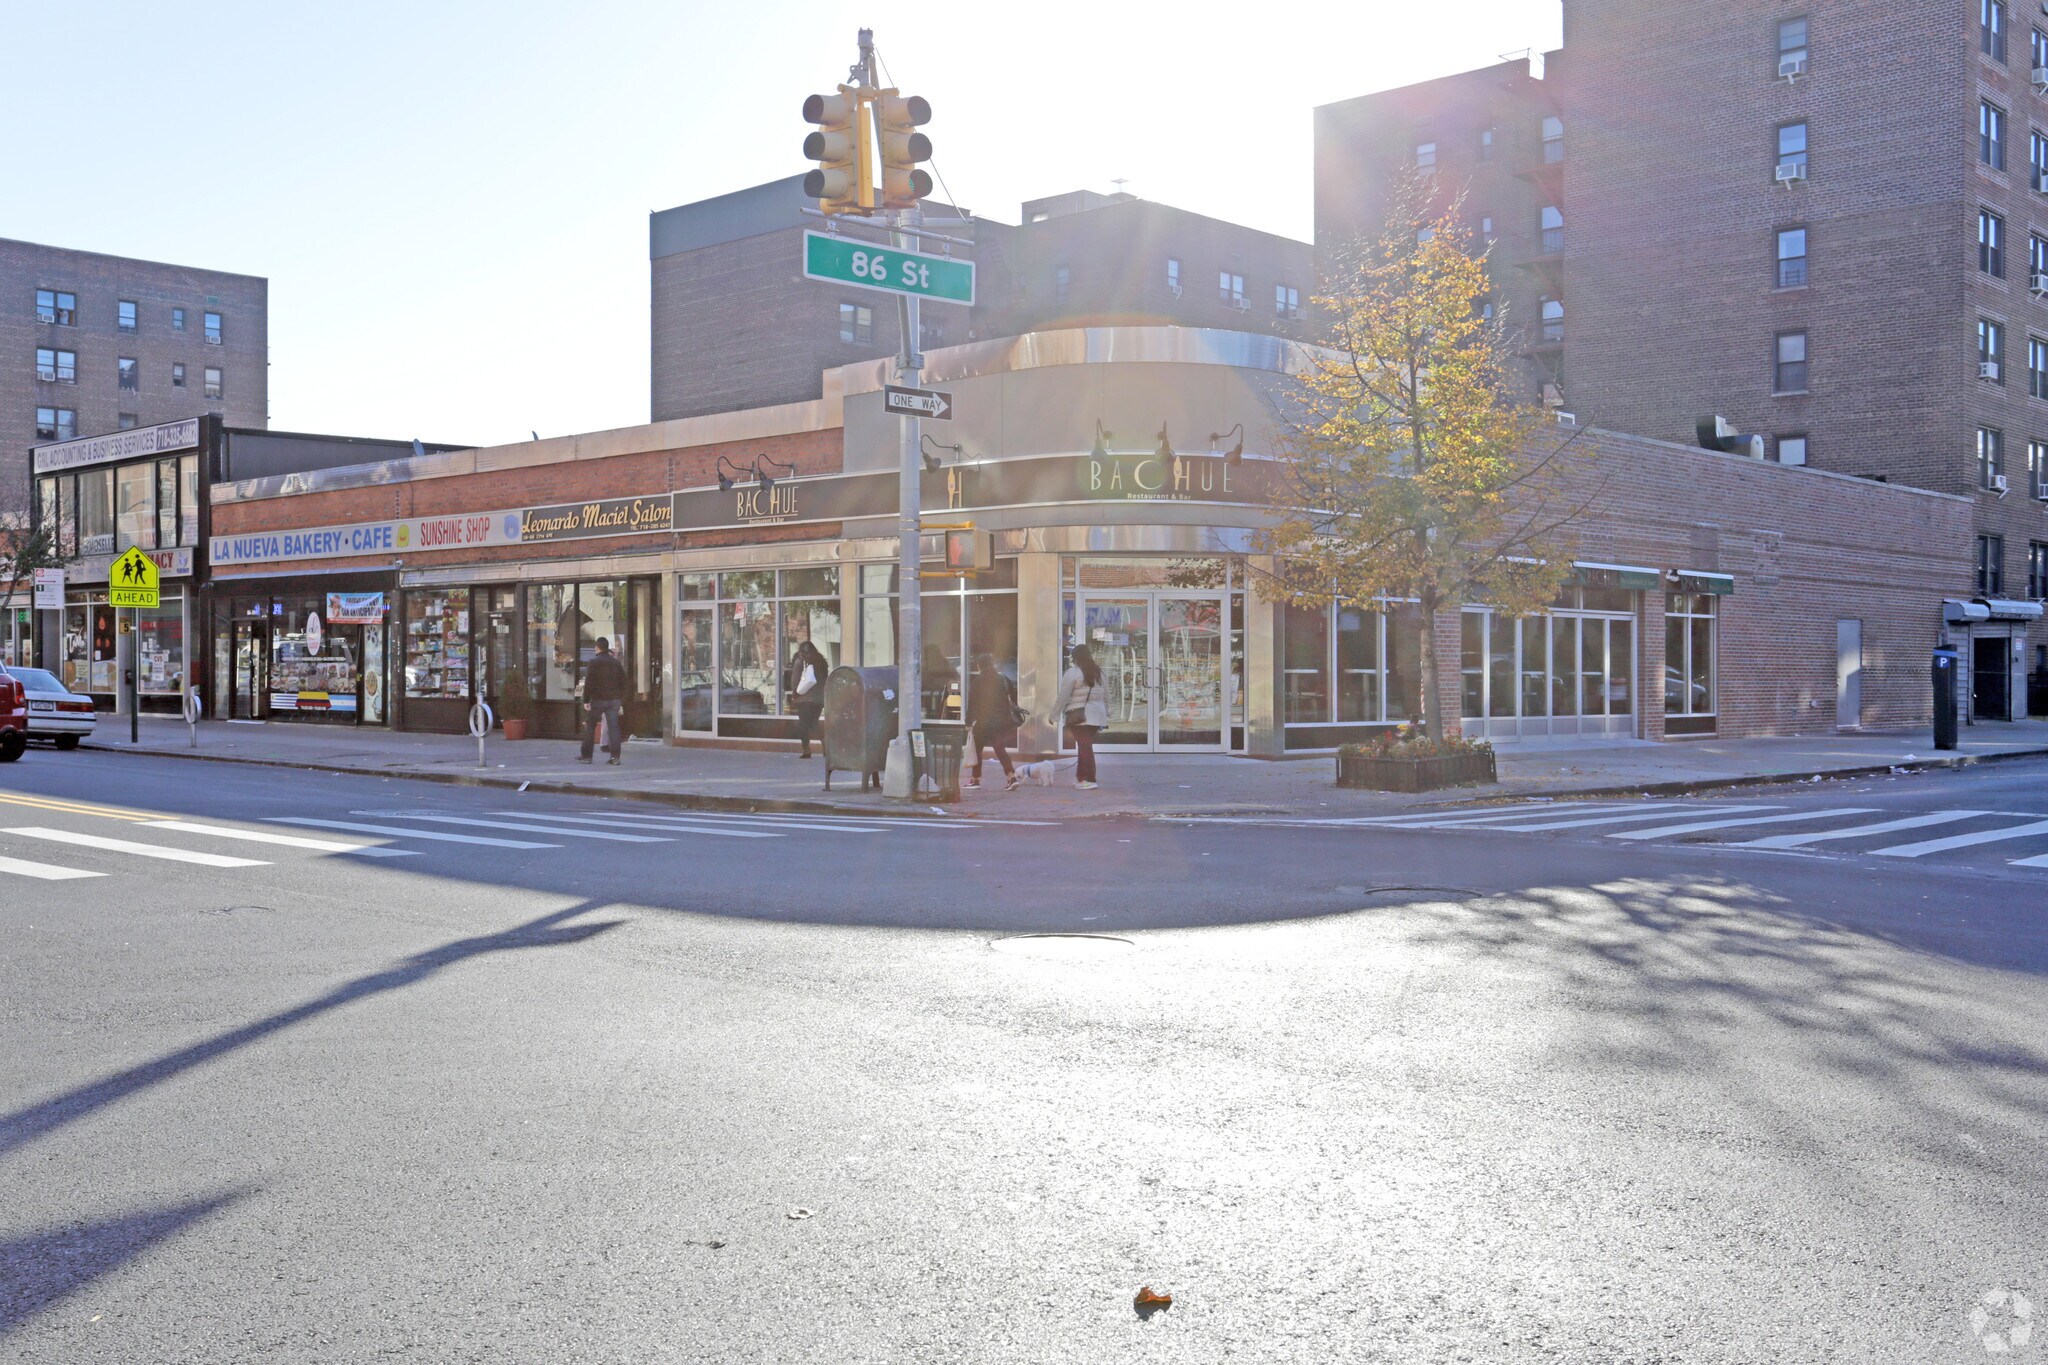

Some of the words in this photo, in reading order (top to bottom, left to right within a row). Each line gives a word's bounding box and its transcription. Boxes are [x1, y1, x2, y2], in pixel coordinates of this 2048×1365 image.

[852, 251, 887, 280] 86
[902, 261, 929, 288] St
[894, 395, 913, 407] ONE
[922, 398, 942, 411] WAY
[50, 444, 86, 466] ACCOUNTING
[93, 437, 122, 459] BUSINESS
[124, 432, 154, 455] SERVICES
[1090, 455, 1233, 493] BACHUE
[736, 484, 799, 517] BACHUE
[1127, 492, 1169, 500] Restaurant
[420, 519, 463, 546] SUNSHINE
[466, 517, 490, 543] SHOP
[522, 510, 580, 534] Leonardo
[582, 503, 629, 529] Maciel
[630, 499, 671, 526] Salon
[214, 540, 230, 561] LA
[234, 537, 279, 559] NUEVA
[284, 531, 342, 555] BAKERY
[352, 526, 392, 550] CAFE
[116, 593, 153, 603] AHEAD
[1940, 657, 1948, 668] P
